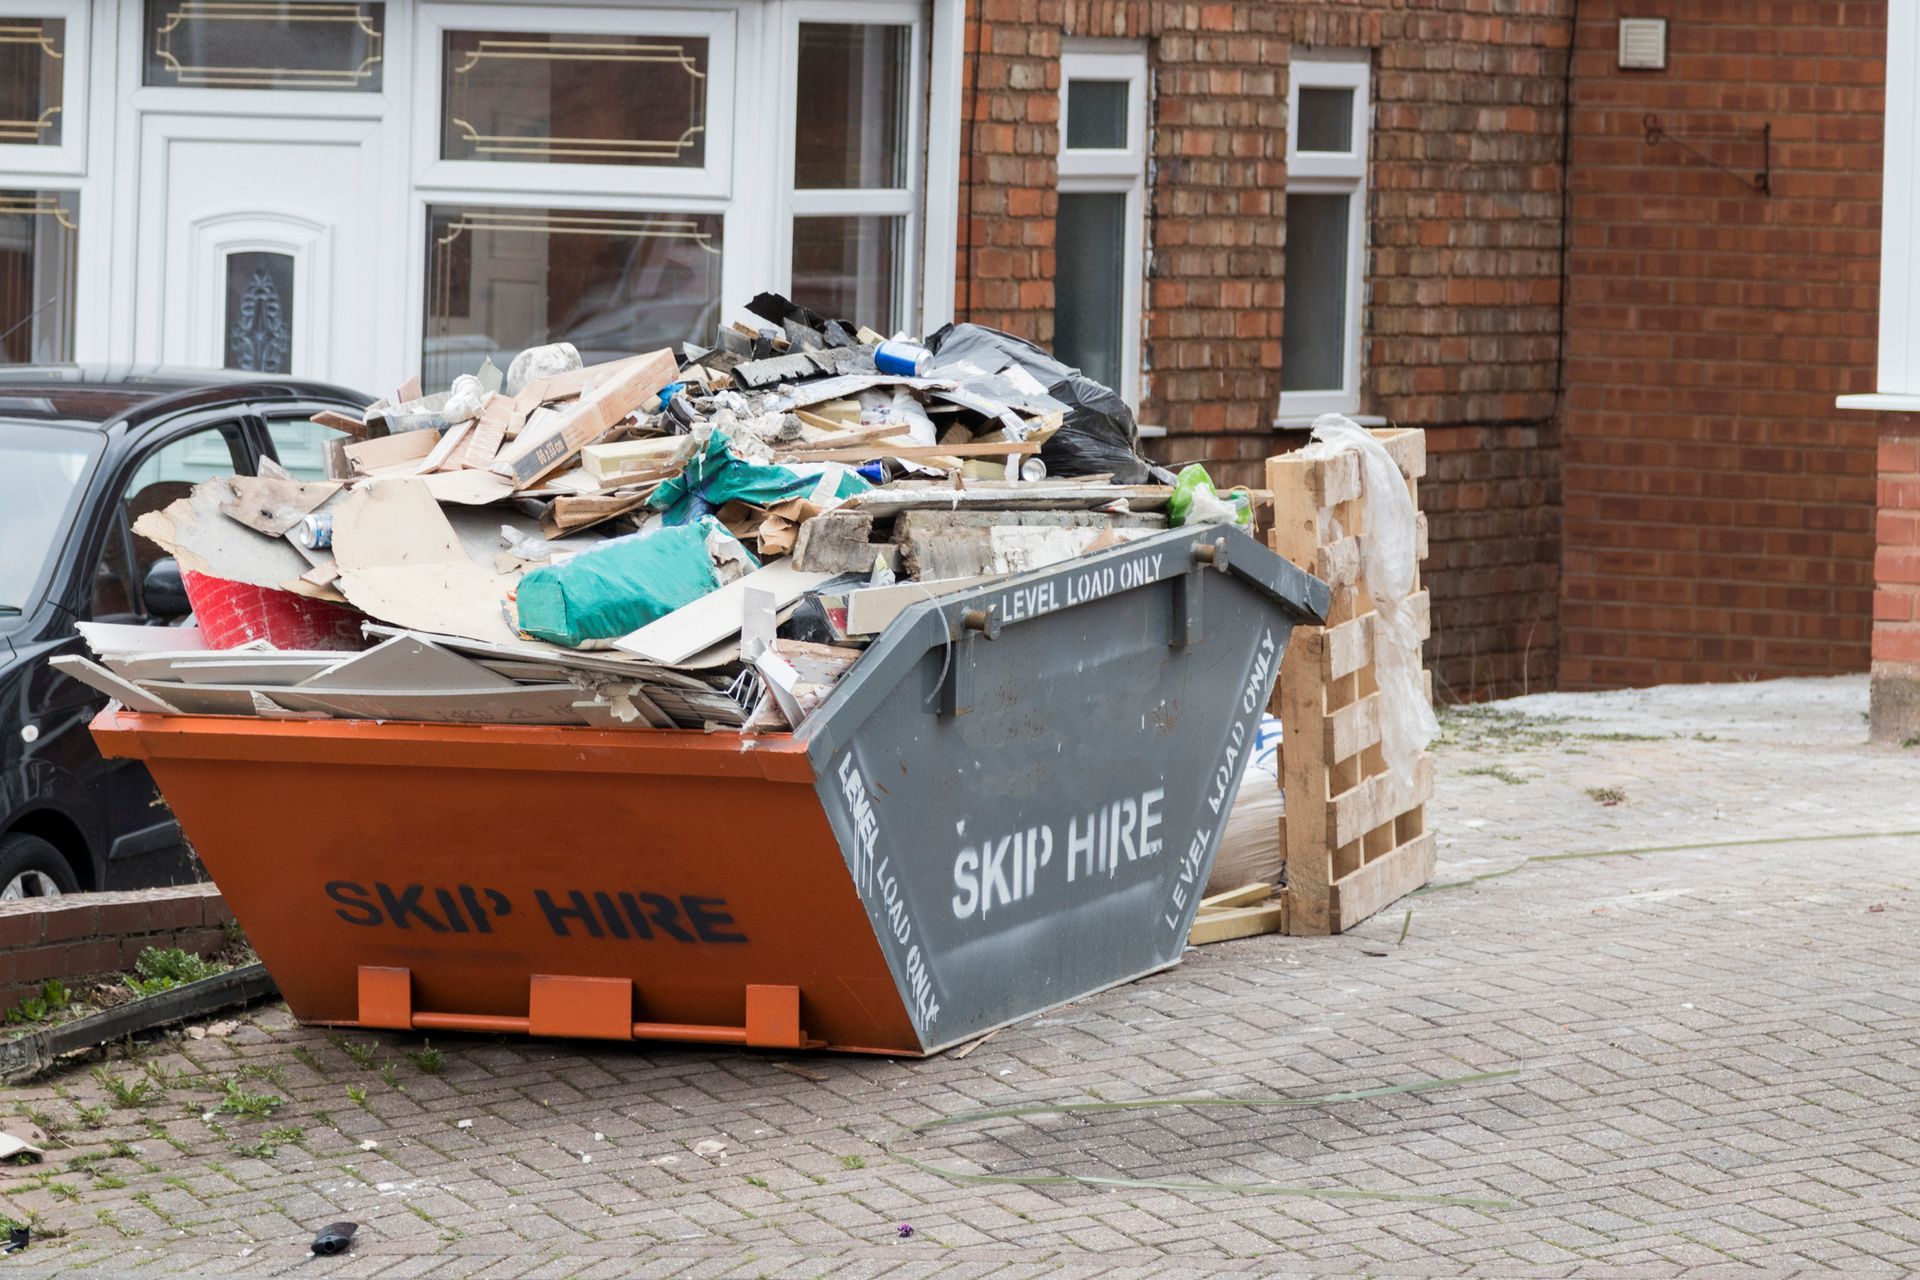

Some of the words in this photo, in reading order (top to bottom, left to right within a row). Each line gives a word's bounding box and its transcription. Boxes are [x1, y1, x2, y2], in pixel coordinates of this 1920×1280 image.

[1002, 581, 1060, 622] LEVEL
[1067, 567, 1115, 605] LOAD
[1120, 553, 1163, 589] ONLY
[1165, 828, 1211, 930] LEVEL
[1208, 720, 1244, 815] LOAD
[1243, 628, 1275, 715] ONLY
[324, 879, 512, 934] SKIP
[534, 888, 749, 944] HIRE
[838, 752, 880, 863] LEVEL
[876, 856, 911, 945] LOAD
[906, 945, 940, 1027] ONLY
[952, 824, 1053, 920] SKIP
[1067, 788, 1164, 882] HIRE
